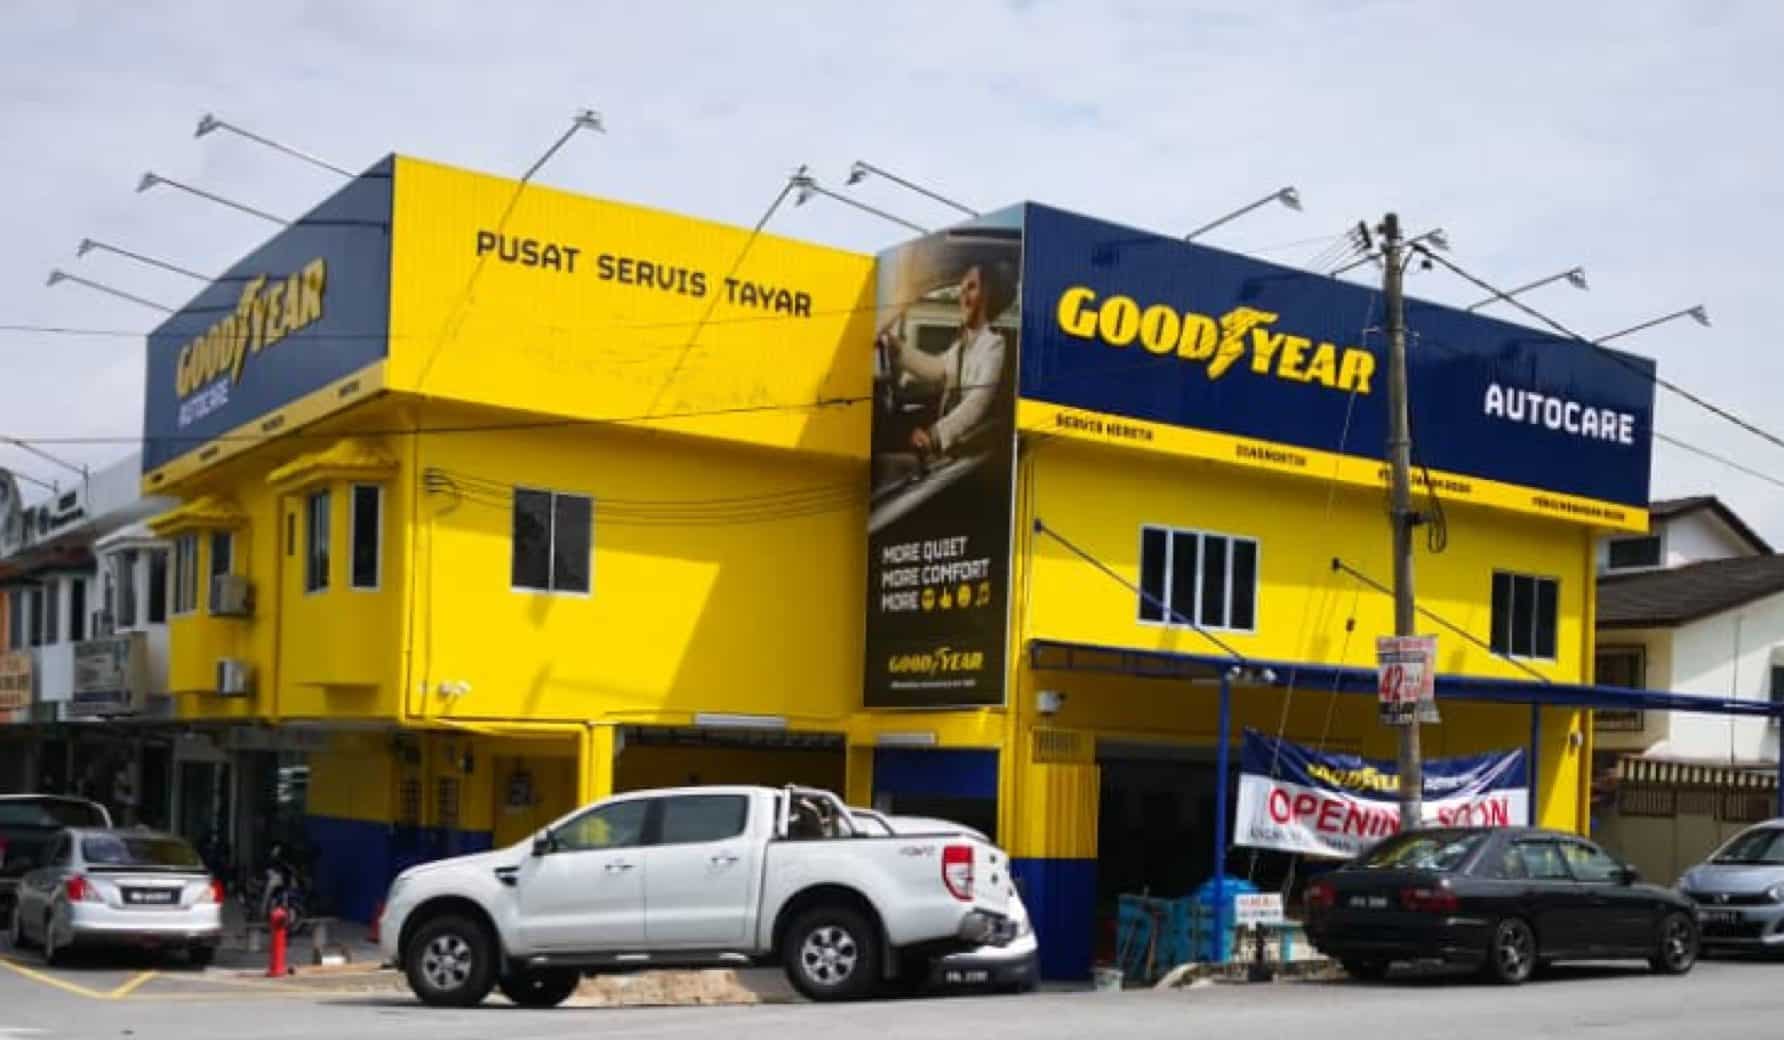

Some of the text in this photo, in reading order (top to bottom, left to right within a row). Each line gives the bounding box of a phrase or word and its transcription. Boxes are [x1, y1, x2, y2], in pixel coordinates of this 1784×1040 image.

[476, 231, 812, 319] PUSAT SERVIS TAYAR
[176, 257, 326, 399] GOODYEAR
[1057, 285, 1376, 395] GOODYEAR
[1484, 382, 1636, 445] AUTOCARE
[882, 536, 968, 563] MORE QUIET
[882, 557, 990, 588] MORE COMFORT
[882, 591, 919, 613] MORE
[1268, 788, 1401, 838] OPENIN
